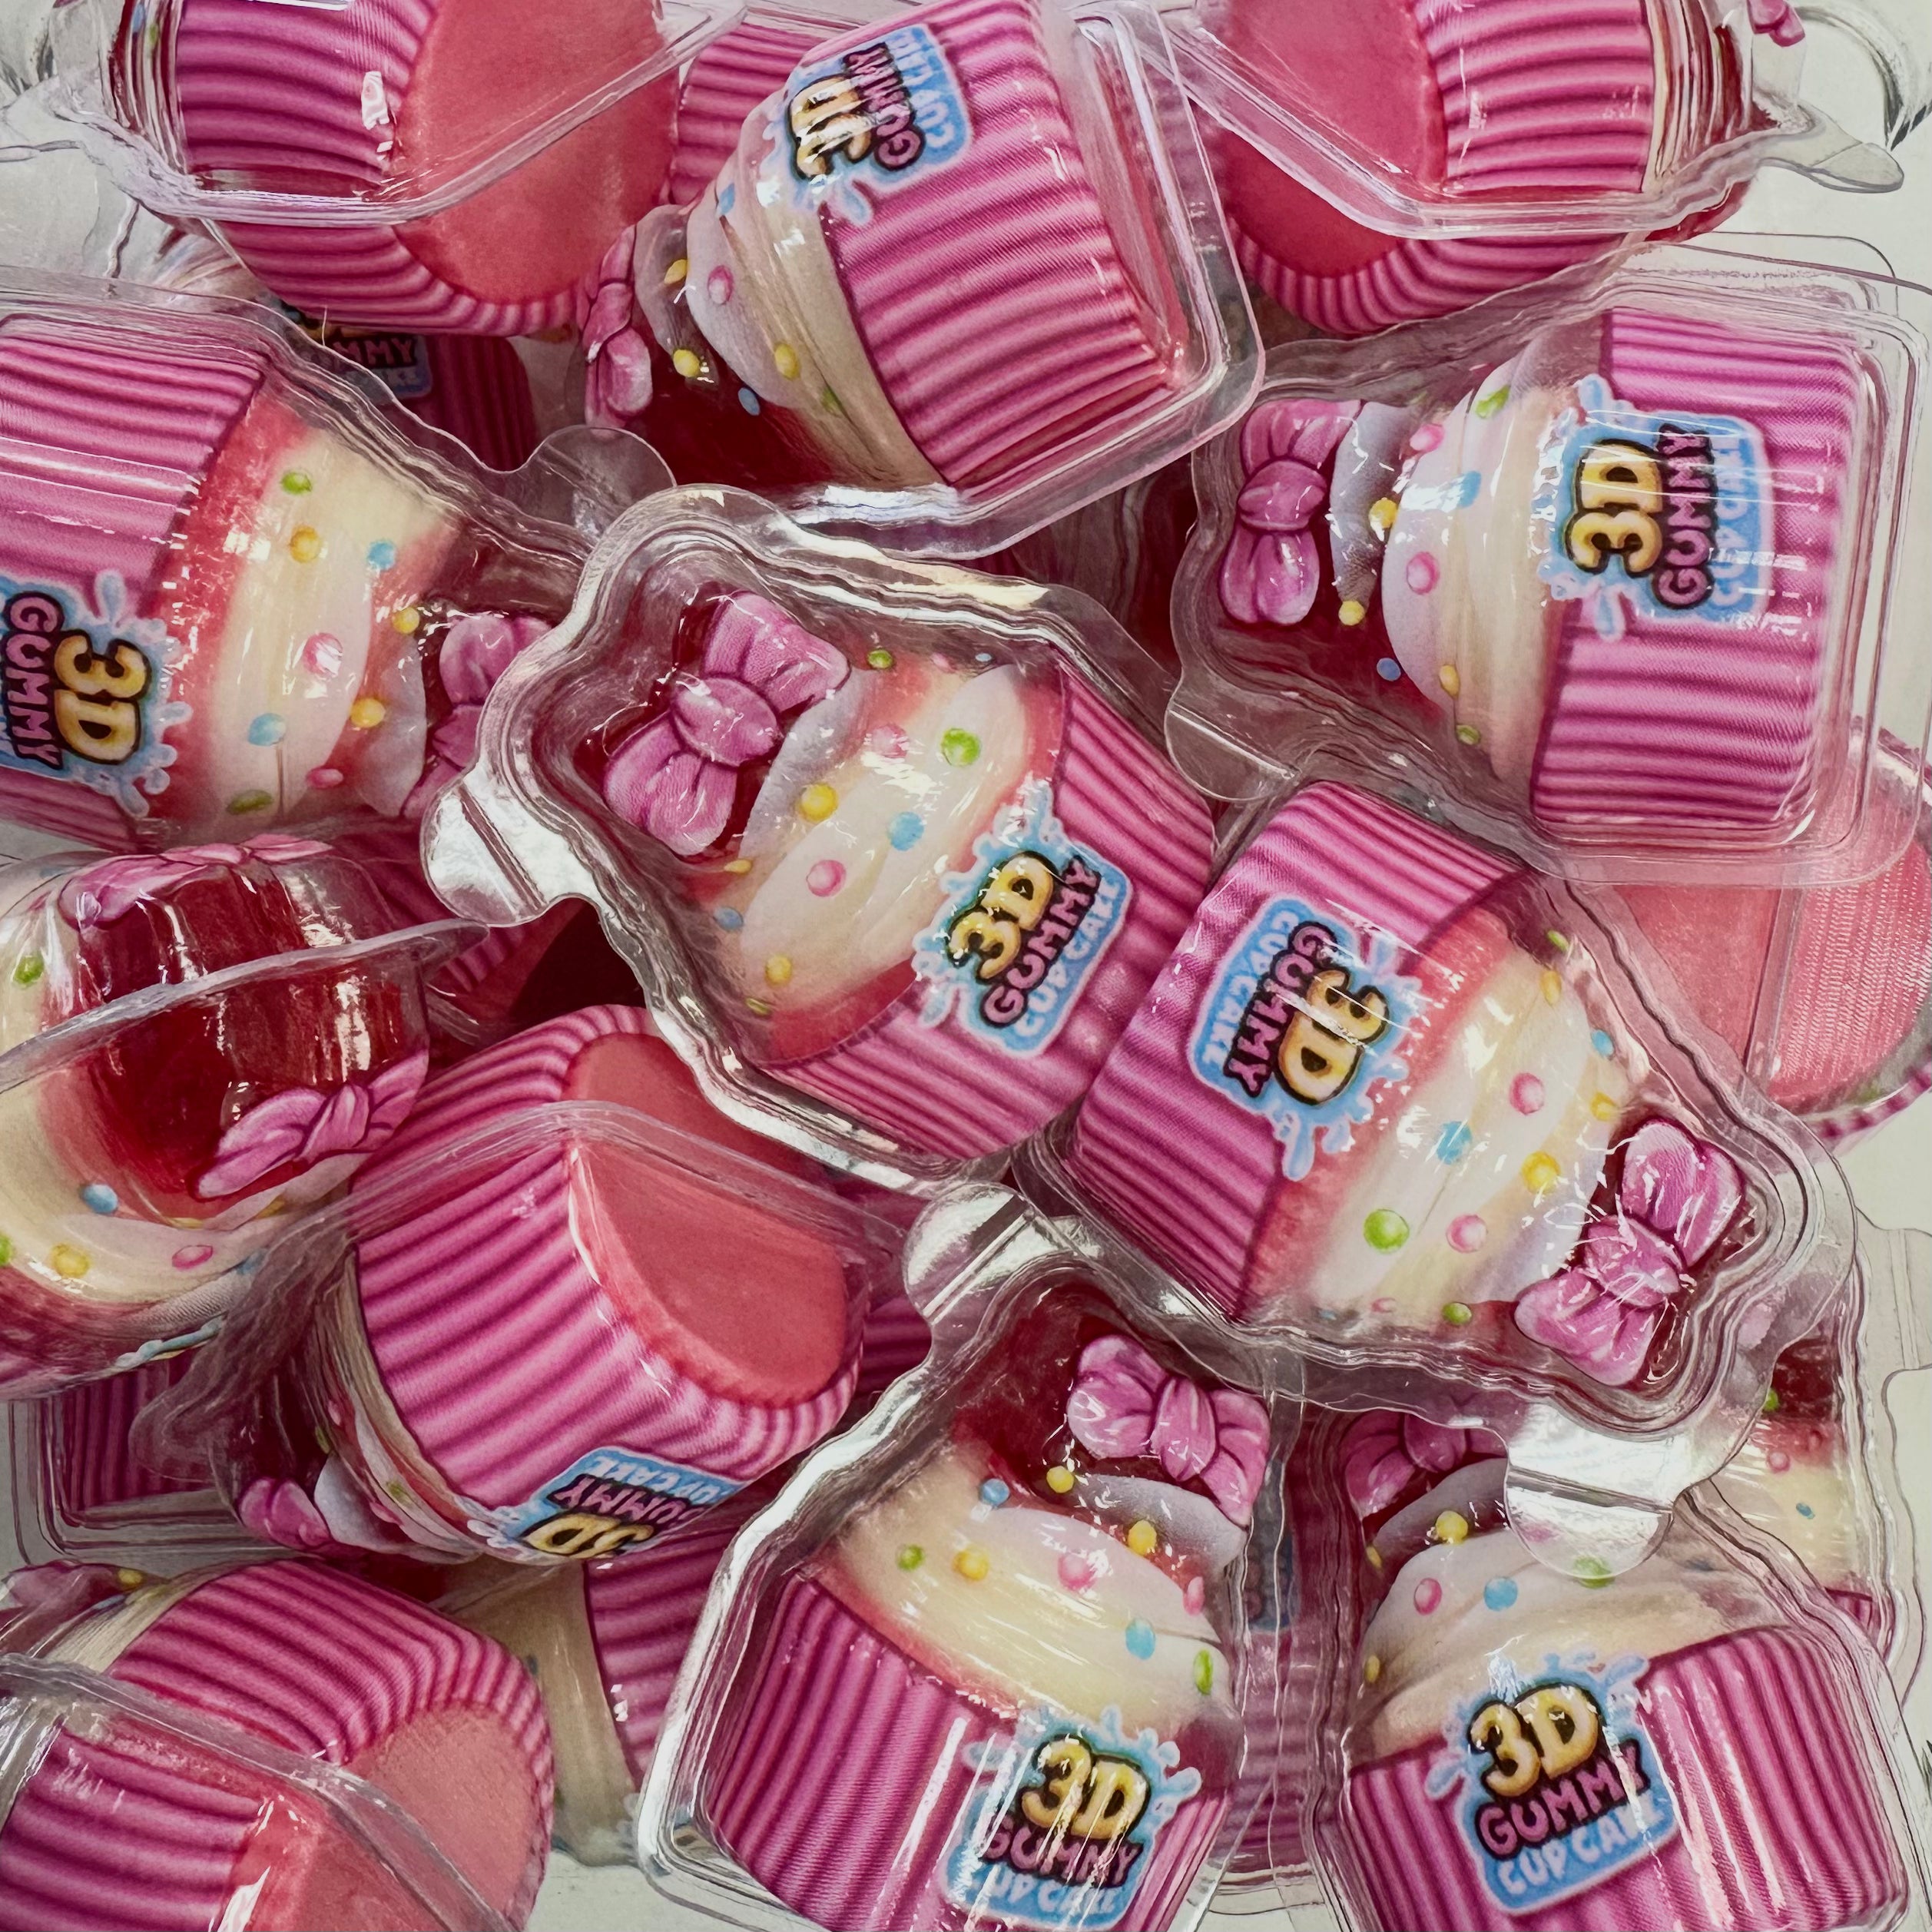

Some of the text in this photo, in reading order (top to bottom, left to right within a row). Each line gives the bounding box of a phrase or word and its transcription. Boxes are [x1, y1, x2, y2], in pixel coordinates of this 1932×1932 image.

[788, 73, 873, 179] 3D
[1568, 441, 1662, 576] 3D
[1656, 424, 1714, 608] GUMMY
[4, 593, 61, 769] GUMMY
[53, 632, 151, 763] 3D
[946, 853, 1055, 983] 3D
[981, 857, 1102, 1026] GUMMY
[1224, 922, 1337, 1095] GUMMY
[1276, 966, 1388, 1104] 3D
[1019, 1735, 1151, 1840] 3D
[1467, 1683, 1600, 1799] 3D
[1476, 1740, 1649, 1859] GUMMY
